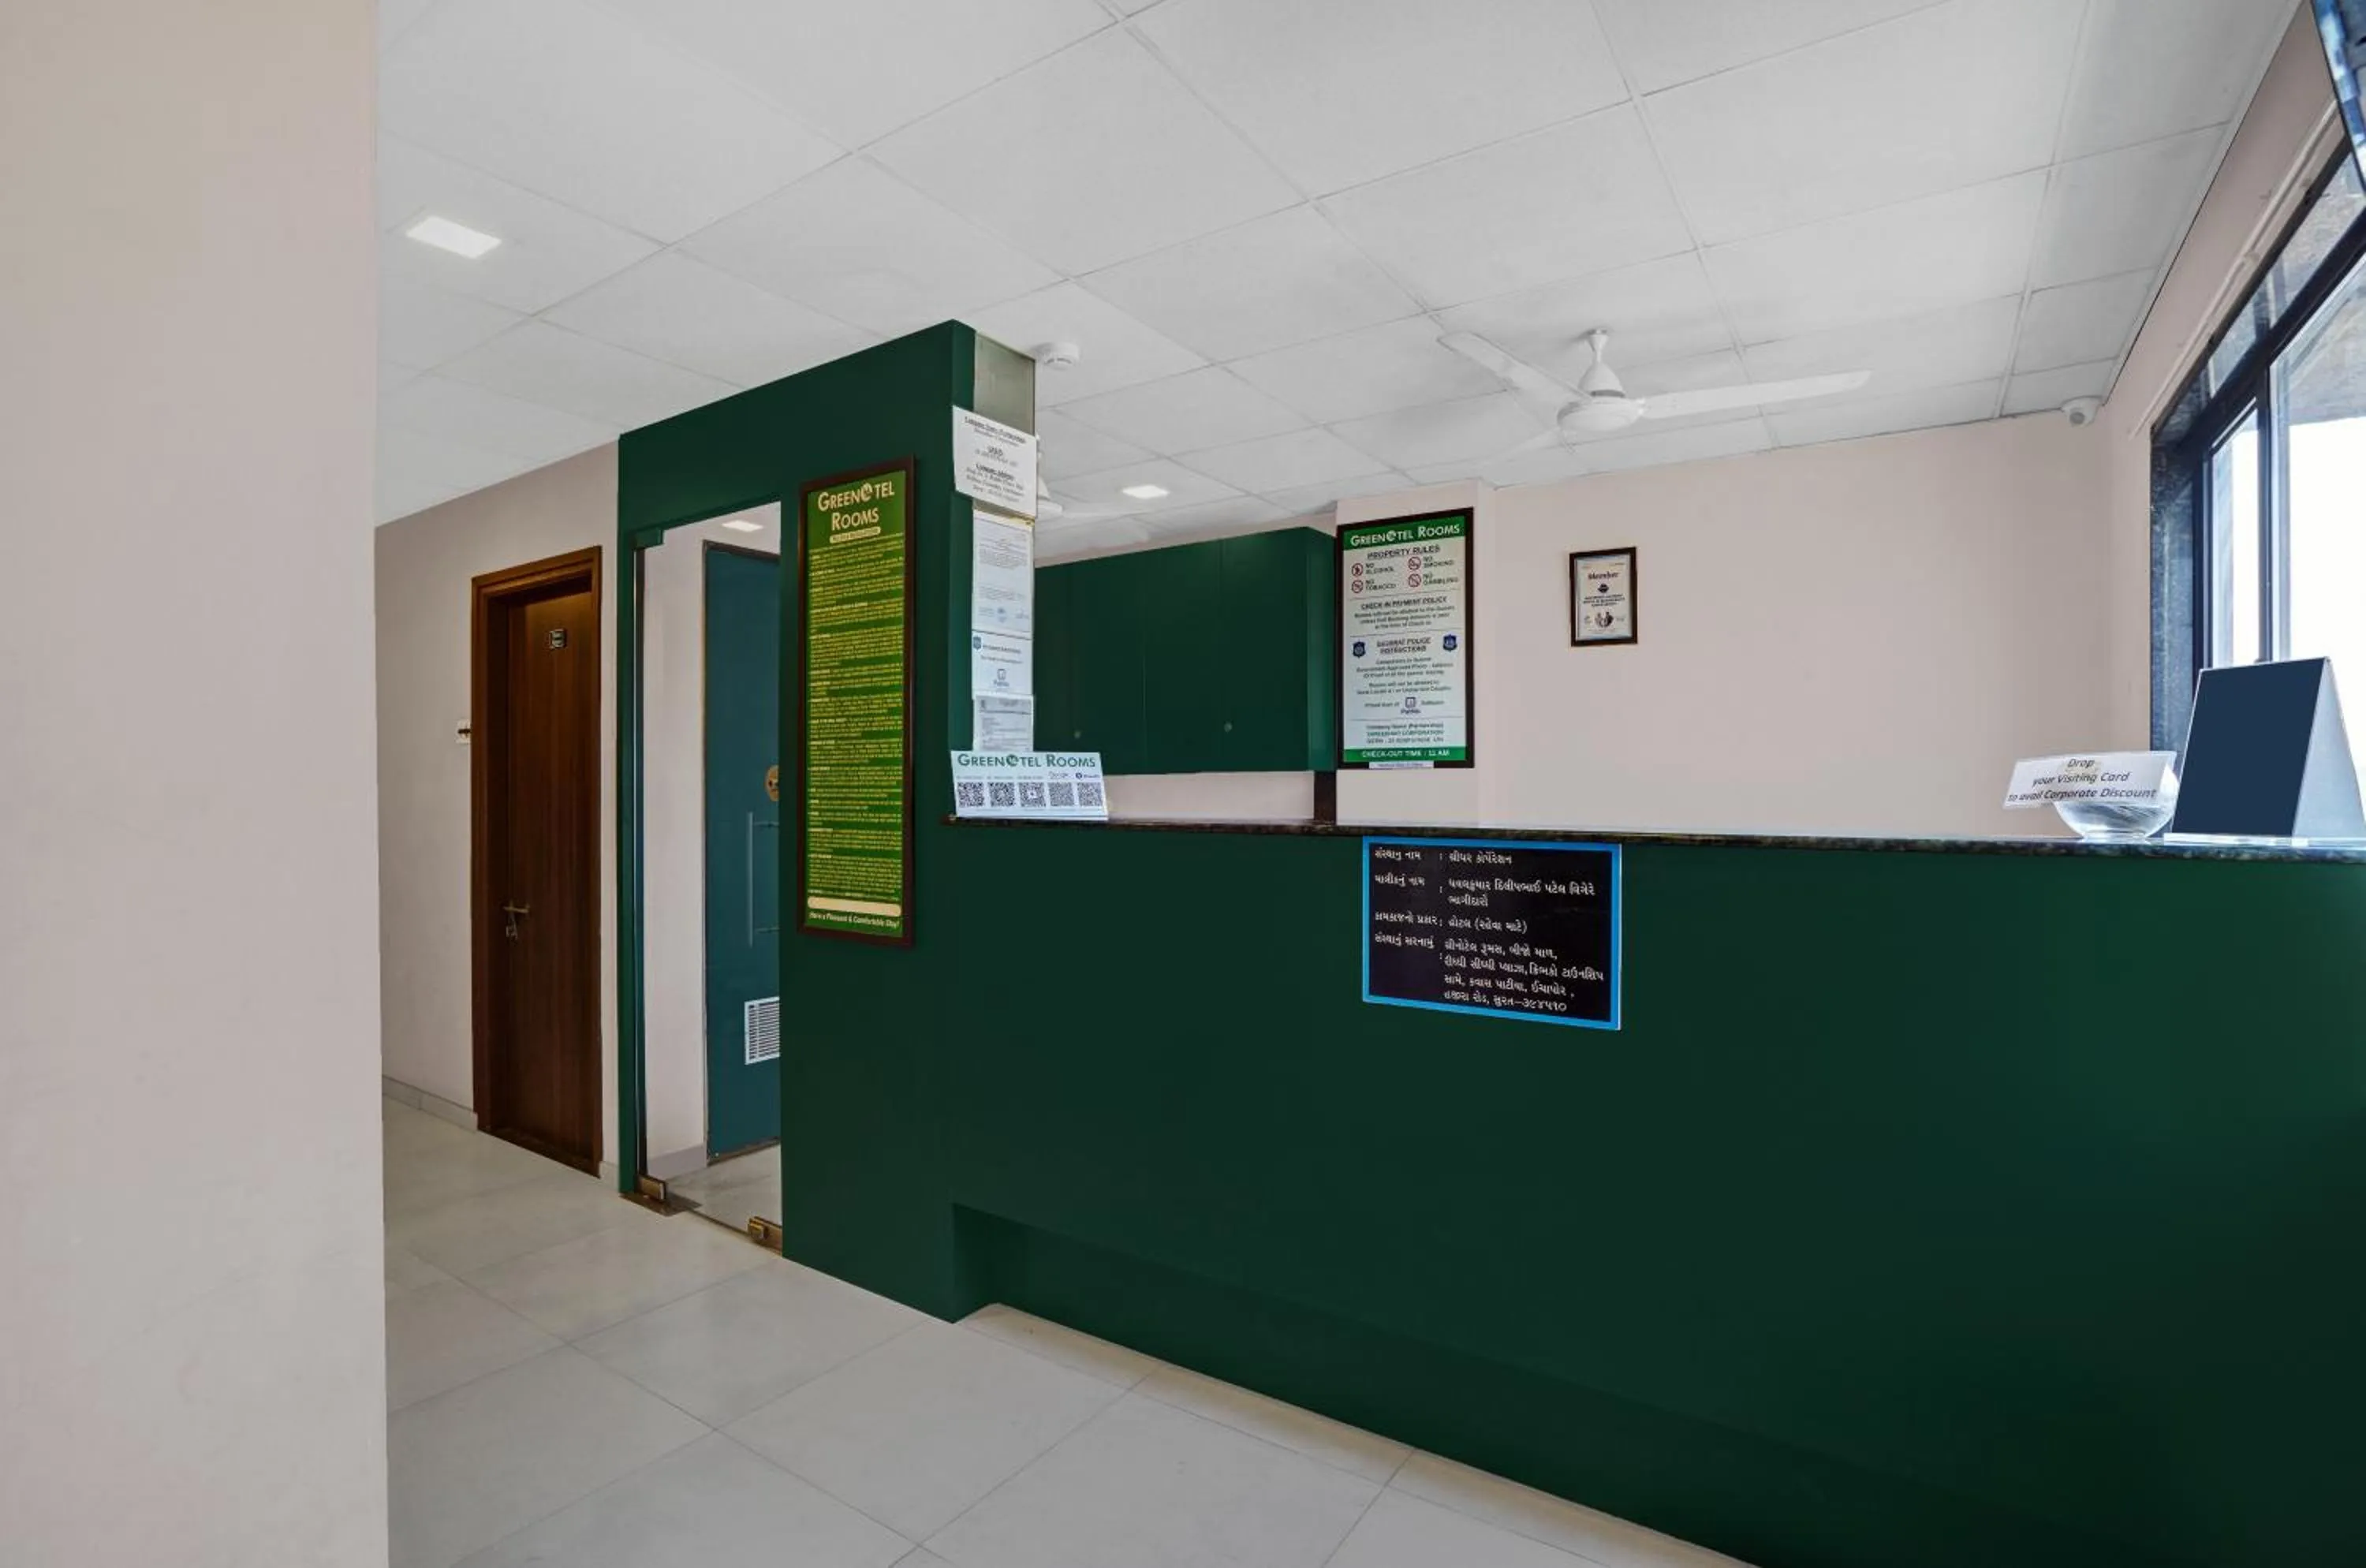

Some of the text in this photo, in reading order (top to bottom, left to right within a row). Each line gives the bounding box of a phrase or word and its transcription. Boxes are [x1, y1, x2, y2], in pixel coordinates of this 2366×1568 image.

[831, 508, 879, 531] ROOMS
[1418, 524, 1461, 538] ROOMS
[1046, 754, 1095, 767] ROOMS
[2067, 758, 2095, 768] Drop
[2032, 772, 2130, 787] your Visiting Card
[2044, 789, 2098, 801] Corporate
[2100, 788, 2157, 798] Discount
[1545, 879, 1566, 894] પટેલ
